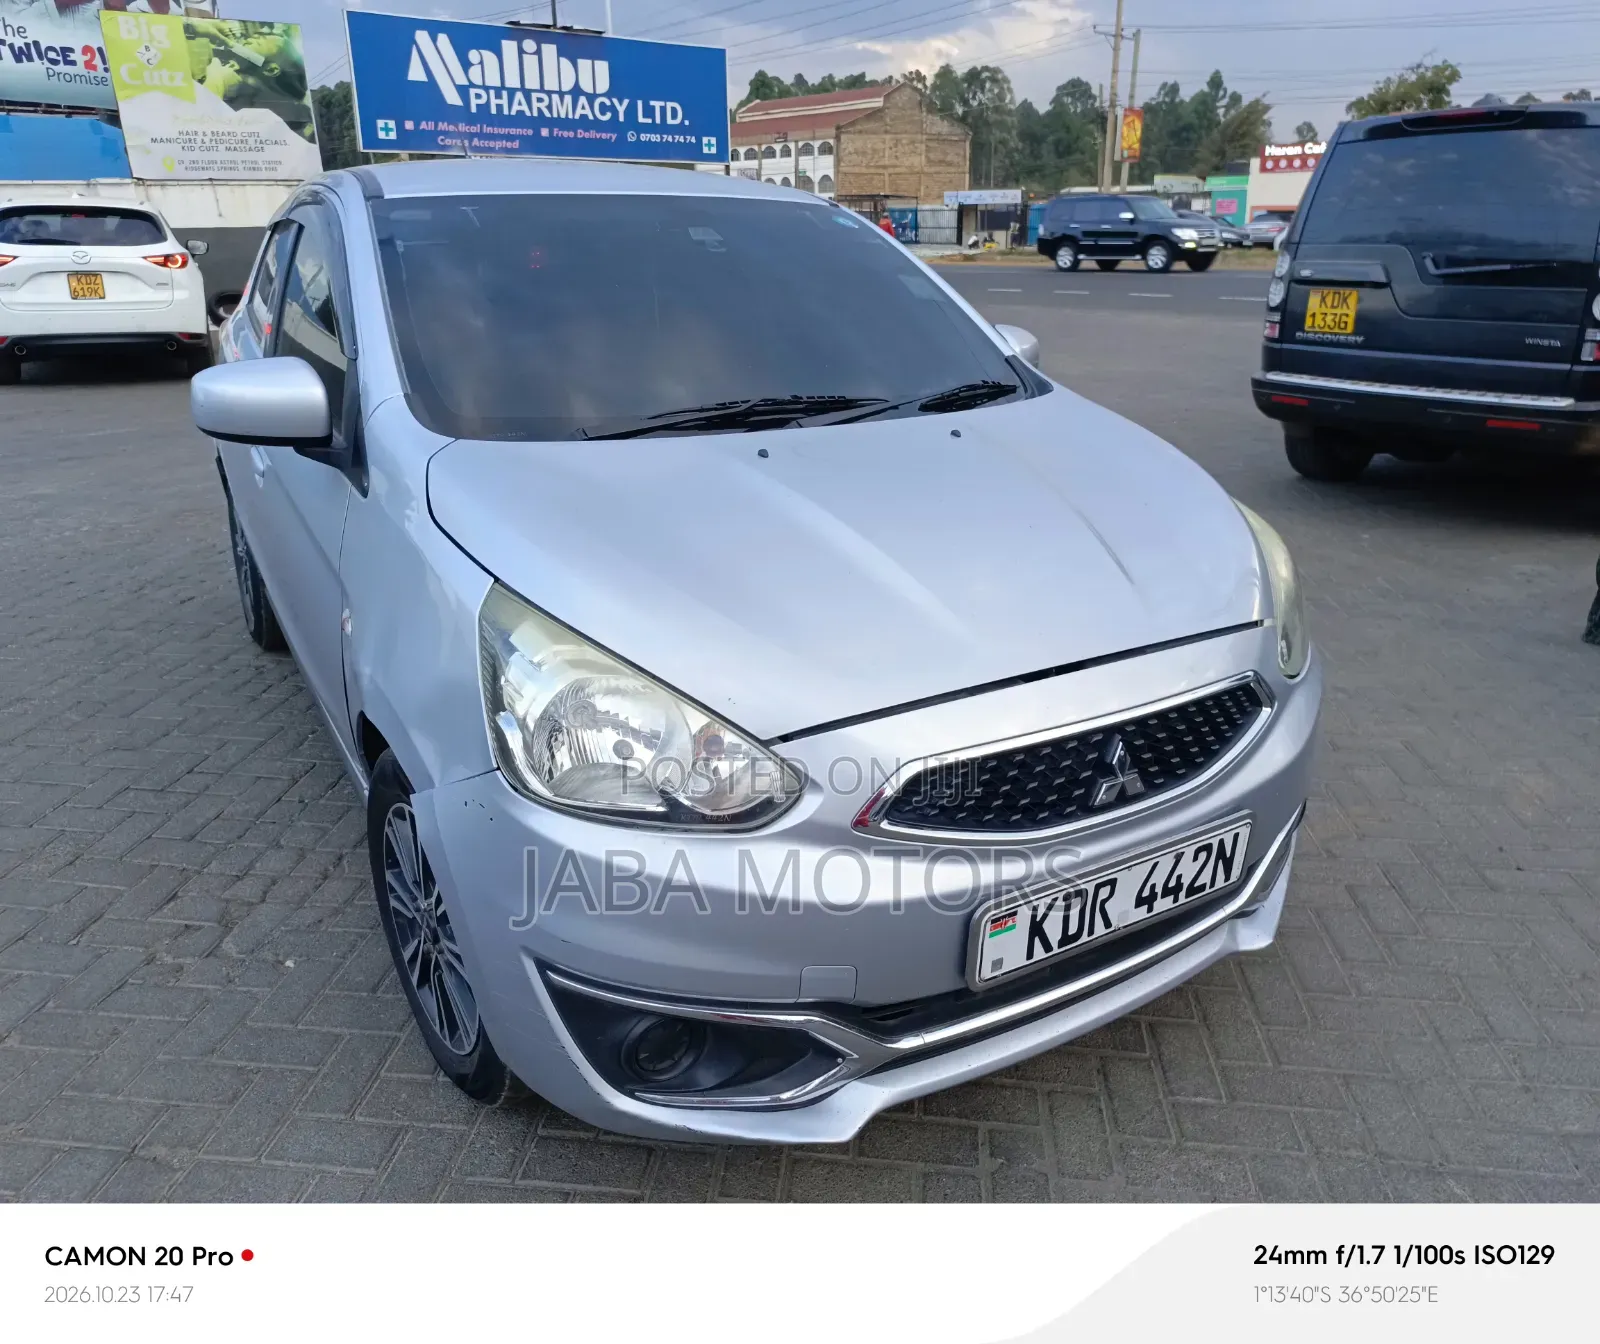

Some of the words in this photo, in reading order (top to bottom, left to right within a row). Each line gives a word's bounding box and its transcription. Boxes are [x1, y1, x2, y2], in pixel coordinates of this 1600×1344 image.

[0, 16, 28, 39] he
[118, 15, 171, 49] Big
[81, 45, 109, 73] 2!
[46, 67, 109, 86] Promise
[120, 63, 188, 87] Cutz
[407, 30, 610, 106] Malibu
[468, 87, 630, 122] PHARMACY
[636, 100, 690, 126] LTD.
[211, 130, 238, 138] BEARD
[419, 120, 435, 131] All
[483, 124, 533, 136] Insurance
[553, 128, 574, 138] Free
[577, 129, 617, 142] Delivery
[150, 137, 198, 145] MANICURE
[472, 137, 519, 151] Accepted
[640, 134, 661, 142] 0703
[662, 135, 673, 143] 74
[674, 135, 684, 143] 74
[685, 136, 696, 144] 74
[1304, 141, 1327, 154] Caf
[76, 274, 100, 286] KDZ
[72, 286, 102, 297] 619K
[1319, 290, 1353, 310] KDK
[1307, 311, 1351, 331] 133G
[1295, 331, 1366, 344] DISCOVERY
[1025, 877, 1118, 961] KDR
[1134, 831, 1240, 915] 442N
